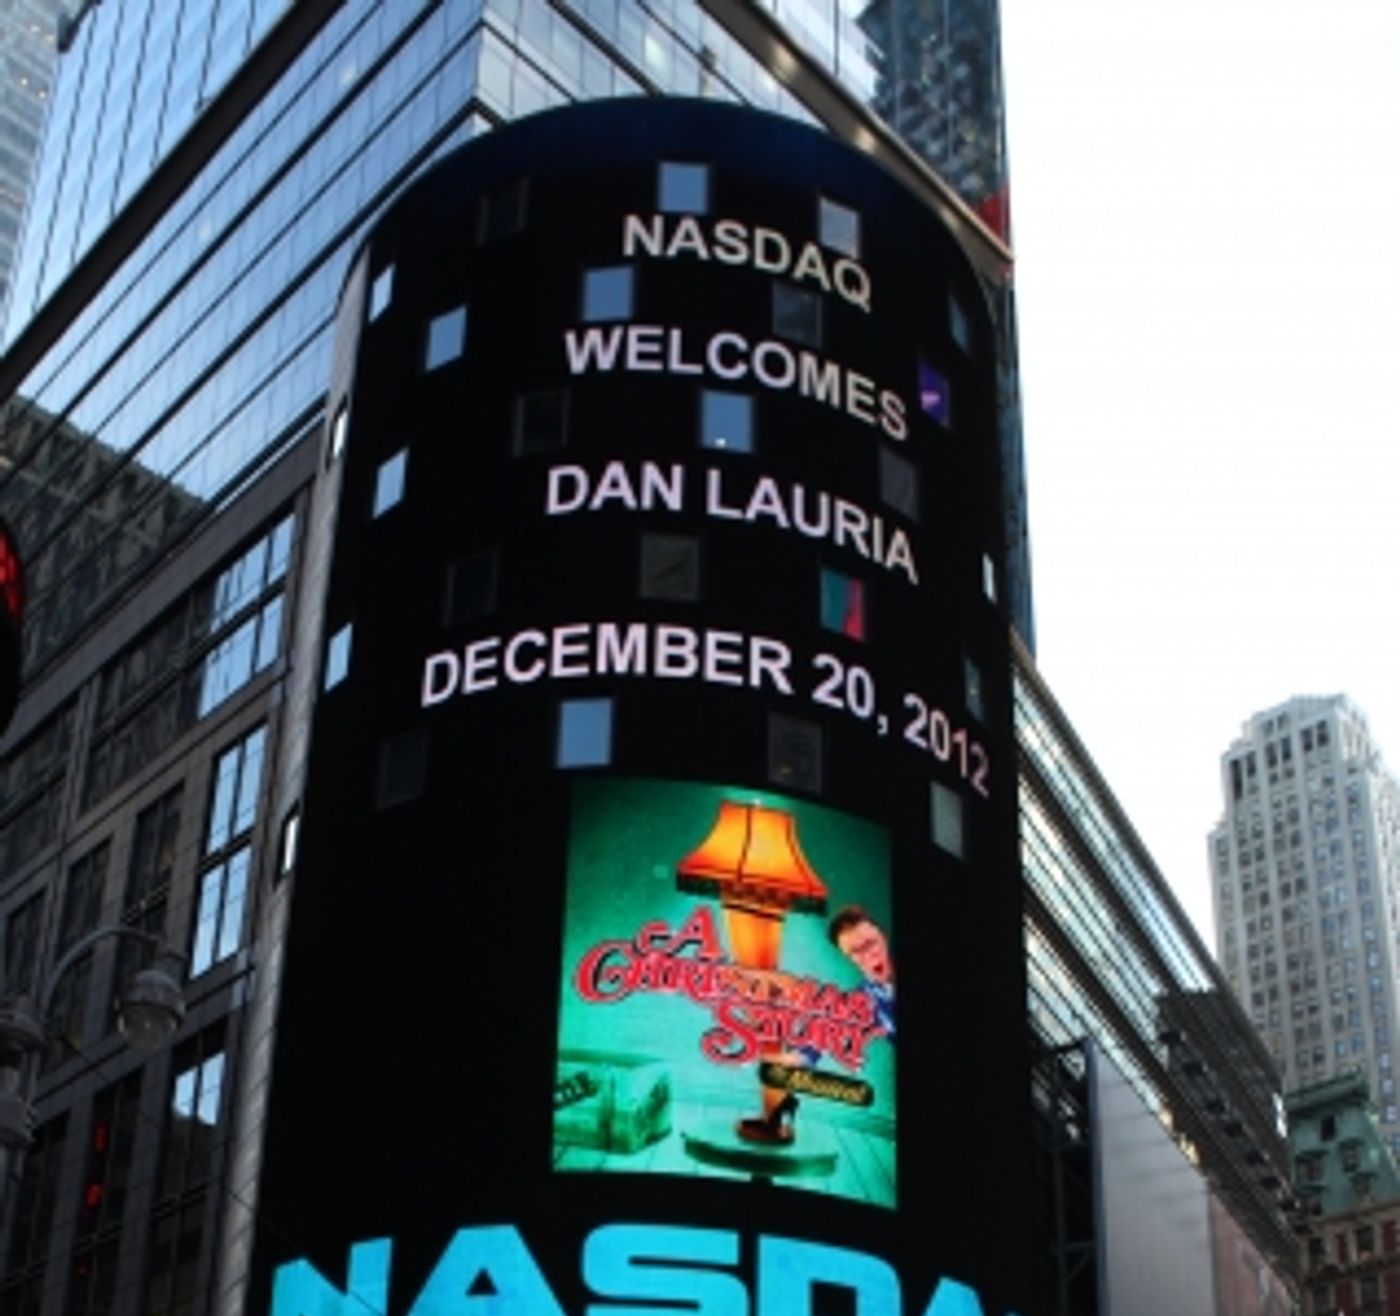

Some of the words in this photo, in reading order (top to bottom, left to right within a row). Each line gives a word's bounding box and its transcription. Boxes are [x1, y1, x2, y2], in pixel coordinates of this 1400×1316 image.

[622, 213, 871, 313] NASDAQ
[564, 325, 908, 441] WELCOMES
[545, 460, 684, 515] DAN
[706, 468, 919, 585] LAURIA
[420, 621, 795, 710] DECEMBER
[811, 652, 889, 735] 20,
[903, 692, 989, 798] 2012
[635, 904, 726, 962] A
